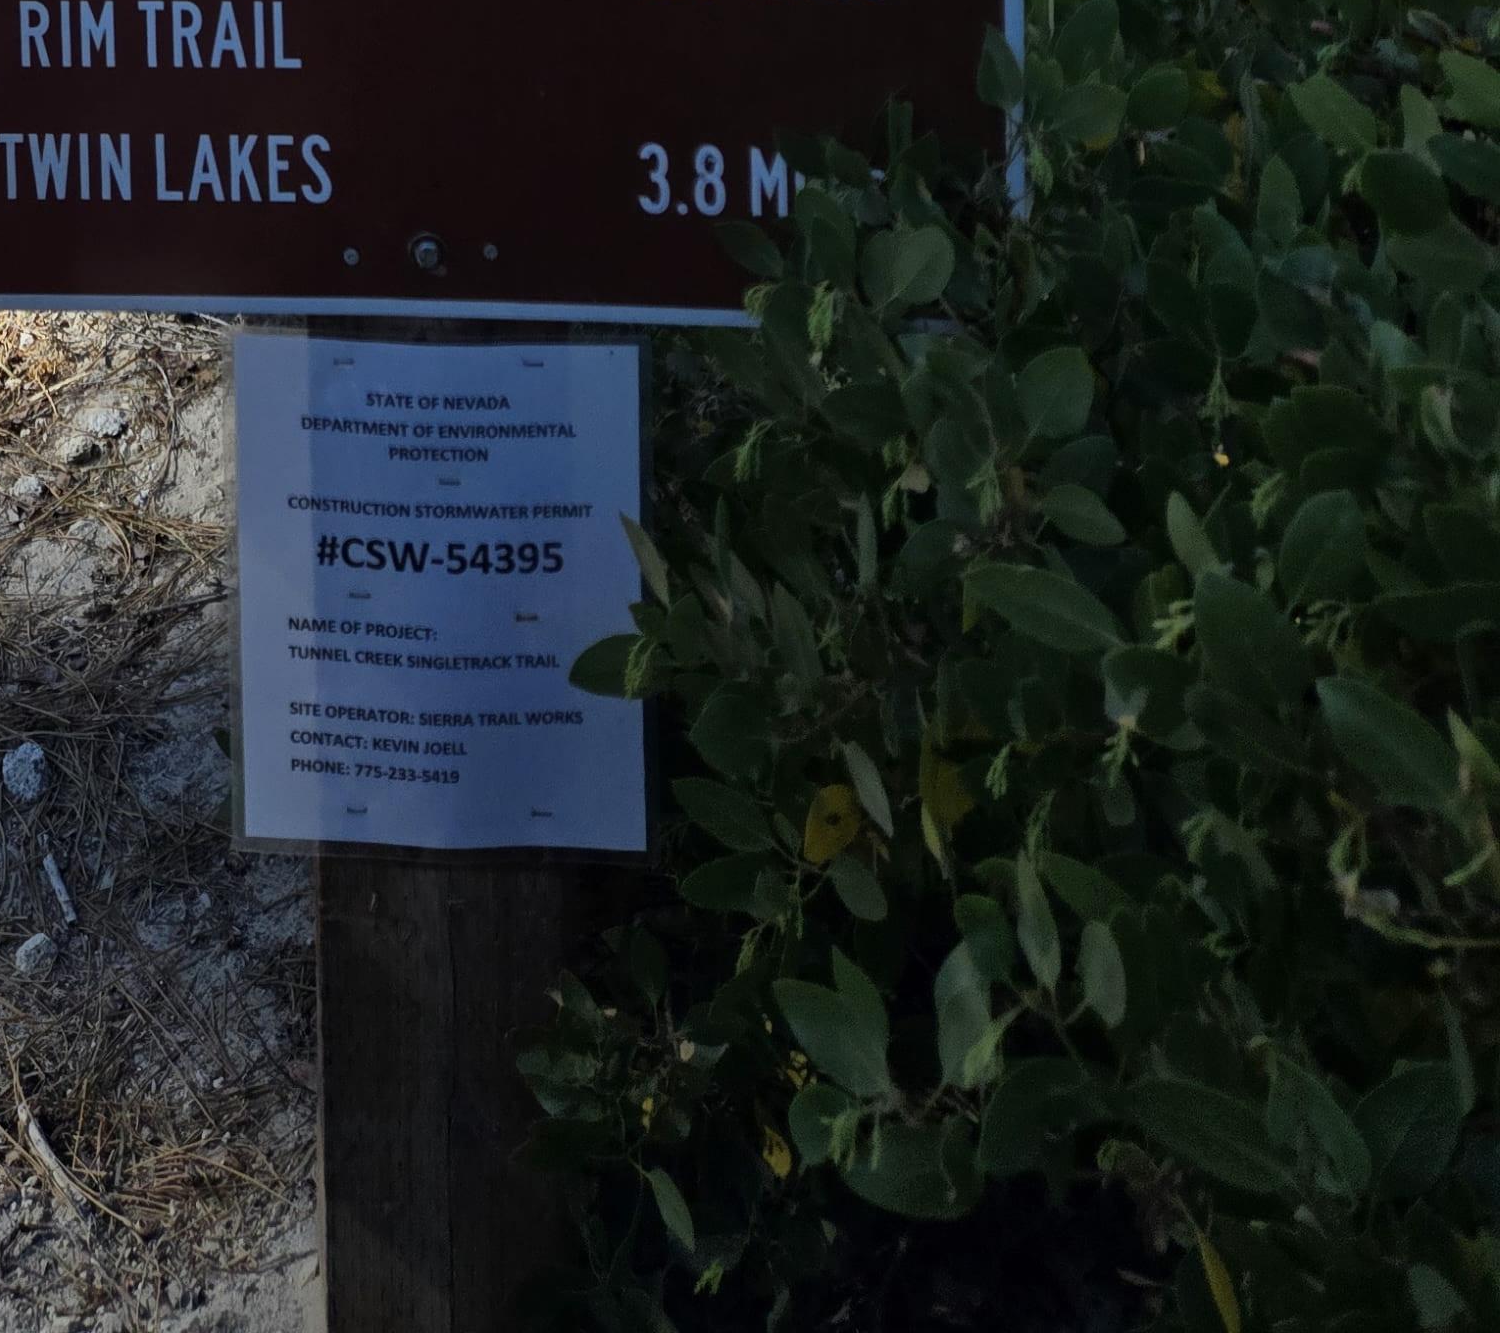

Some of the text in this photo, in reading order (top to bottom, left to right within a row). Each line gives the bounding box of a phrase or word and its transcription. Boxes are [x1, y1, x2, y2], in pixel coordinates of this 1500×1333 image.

[20, 1, 301, 68] RIM TRAIL
[155, 134, 332, 203] LAKES
[639, 143, 725, 215] 3.8
[366, 392, 510, 410] STATE OF NEVADA
[301, 417, 576, 439] DEPARTMENT OF ENVIRONMENTAL
[388, 445, 488, 462] PROTECTION
[288, 495, 593, 519] CONSTRUCTION STORMWATER PERMIT
[317, 535, 563, 574] #CSW-54395
[289, 617, 437, 641] NAME OF PROJECT:
[288, 645, 560, 670] TUNNEL CREEK SINGLETRACK TRAIL
[290, 702, 583, 728] SITE OPERATOR: SIERRA TRAIL WORKS
[290, 730, 467, 756] CONTACT: KEVIN JOELL
[291, 758, 350, 775] PHONE:
